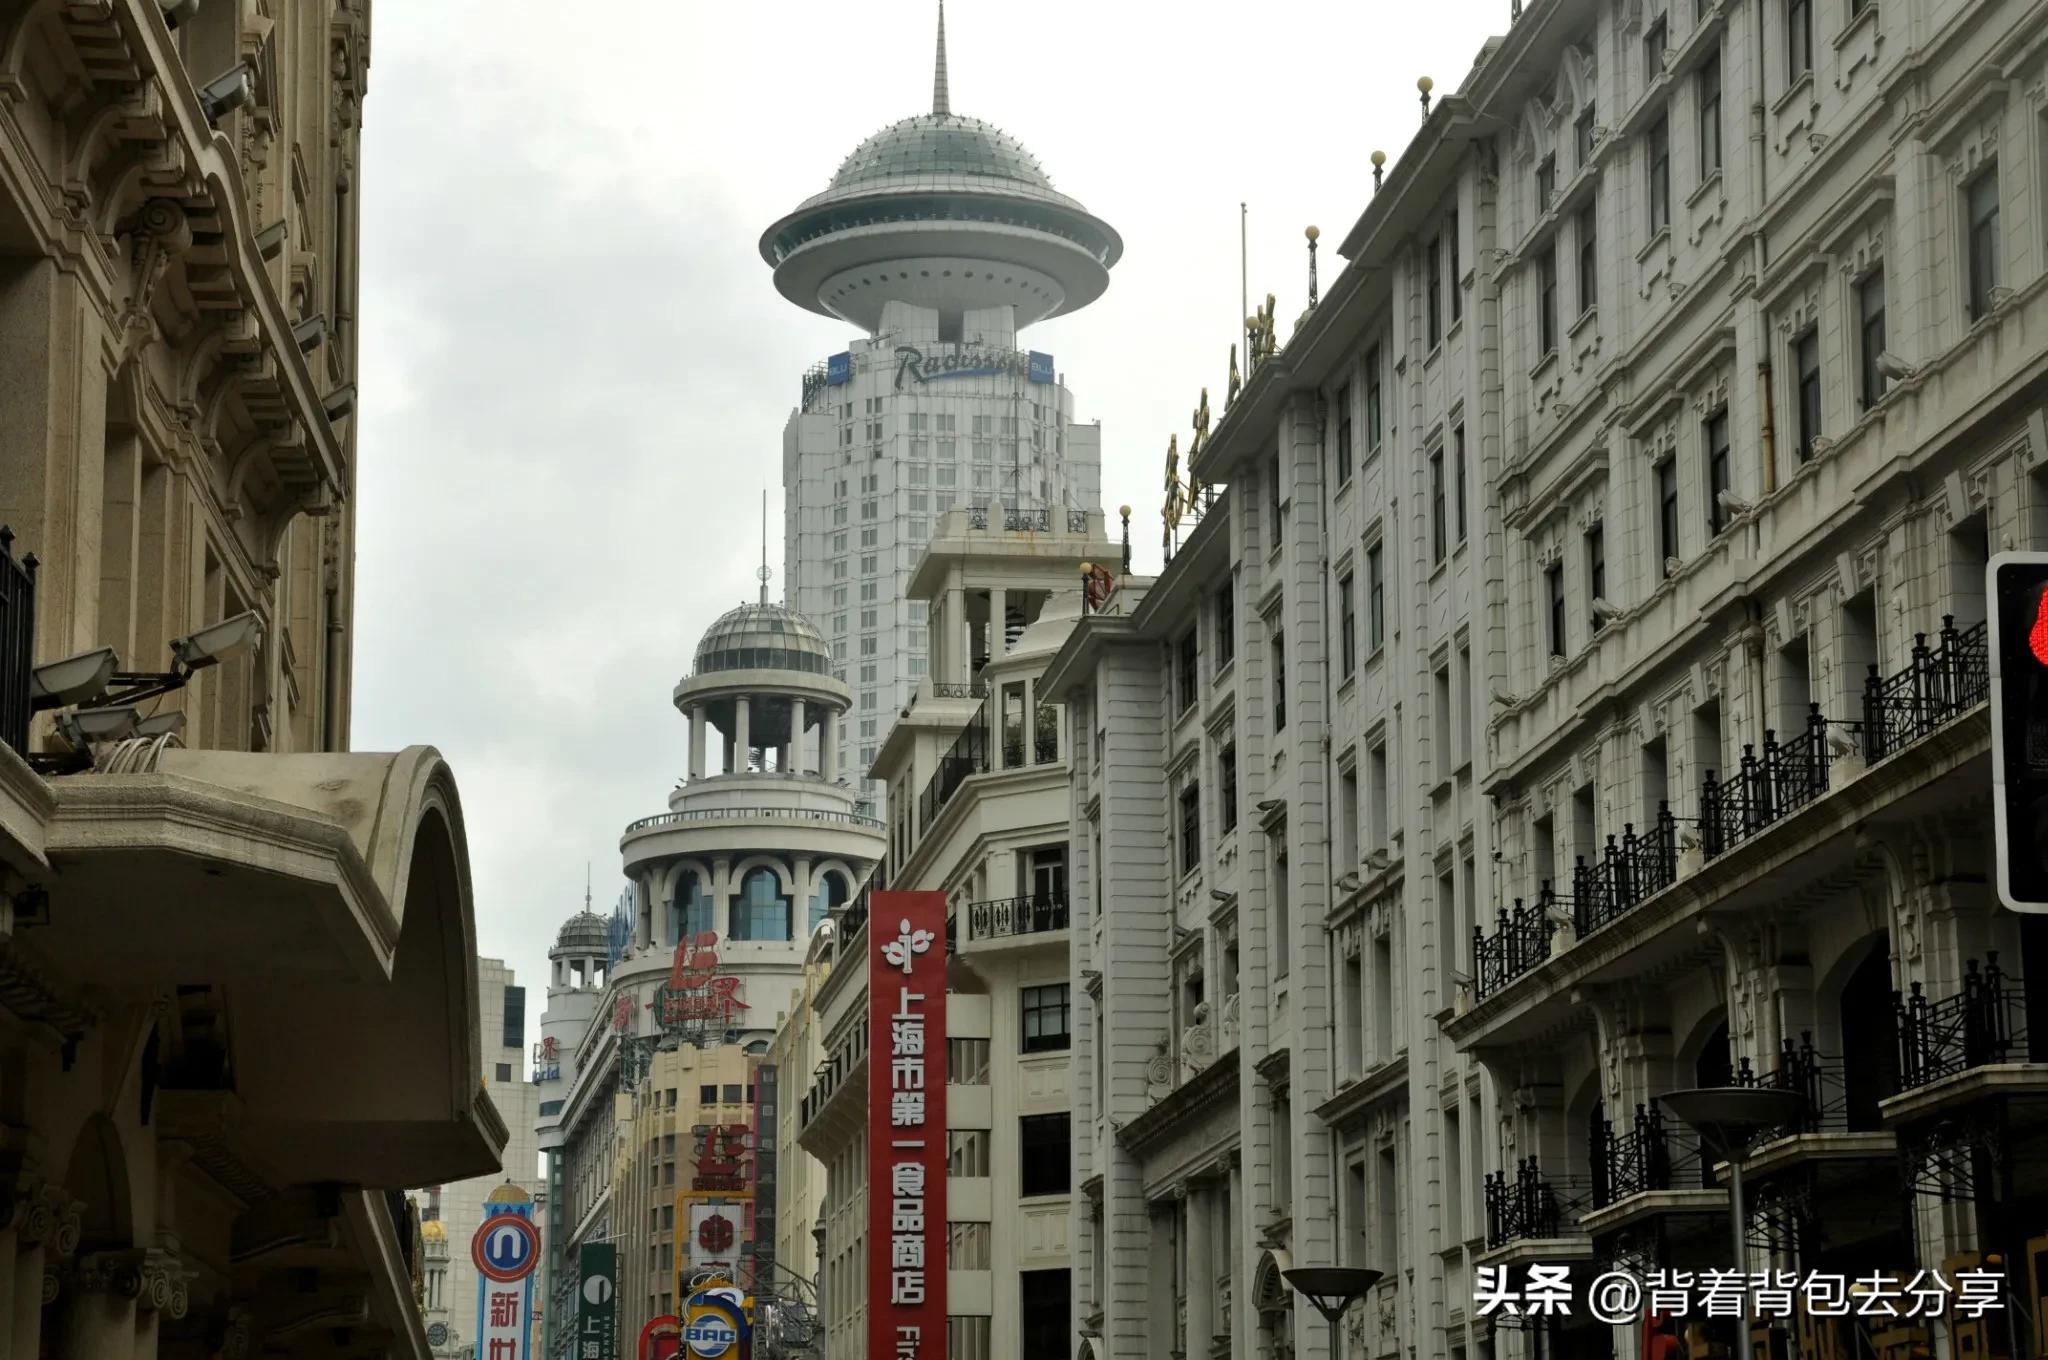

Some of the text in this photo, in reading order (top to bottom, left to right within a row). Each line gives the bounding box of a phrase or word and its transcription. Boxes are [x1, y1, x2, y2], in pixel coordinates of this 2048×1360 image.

[891, 987, 925, 1304] 上海市第一食品商店
[896, 1326, 920, 1360] Fir
